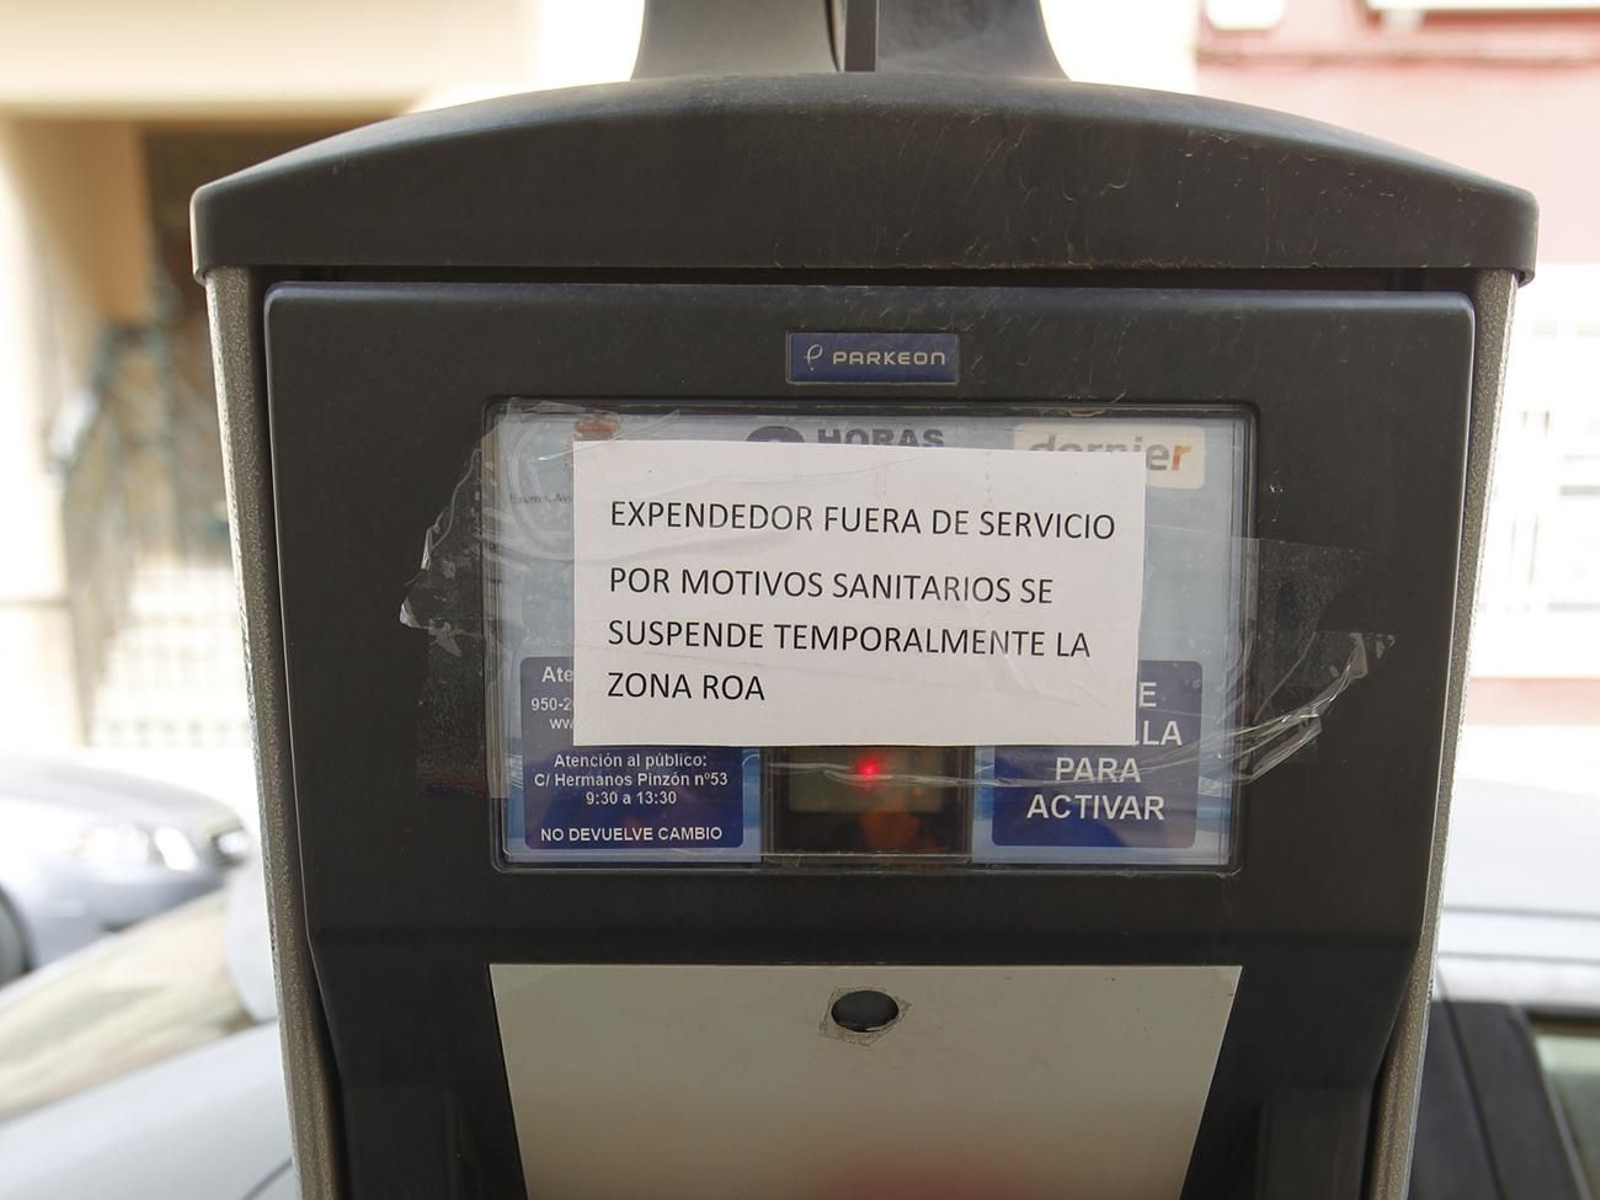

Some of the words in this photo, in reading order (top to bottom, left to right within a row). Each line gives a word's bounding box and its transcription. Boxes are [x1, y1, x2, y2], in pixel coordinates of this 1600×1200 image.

[832, 351, 946, 365] PARKEON
[610, 501, 813, 531] EXPENDEDOR
[824, 506, 922, 534] FUERA
[931, 510, 969, 535] DE
[979, 511, 1115, 539] SERVICIO
[610, 567, 670, 593] POR
[681, 569, 823, 597] MOTIVOS
[832, 573, 1011, 603] SANITARIOS
[1020, 578, 1053, 604] SE
[608, 620, 764, 648] SUSPENDE
[774, 624, 1045, 657] TEMPORALMENTE
[1056, 632, 1091, 658] LA
[607, 672, 692, 699] ZONA
[703, 675, 765, 701] ROA
[1135, 720, 1183, 746] LA
[554, 753, 621, 768] Atención
[627, 753, 641, 768] al
[645, 752, 707, 771] público:
[1055, 757, 1141, 783] PARA
[534, 773, 550, 787] C/
[554, 773, 633, 787] Hermanos
[637, 772, 690, 787] Pinzón
[586, 791, 619, 806] 9:30
[622, 794, 631, 805] a
[636, 790, 677, 805] 13:30
[1026, 794, 1165, 821] ACTIVAR
[540, 828, 564, 841] NO
[569, 827, 653, 841] DEVUELVE
[658, 827, 722, 840] CAMBIO
